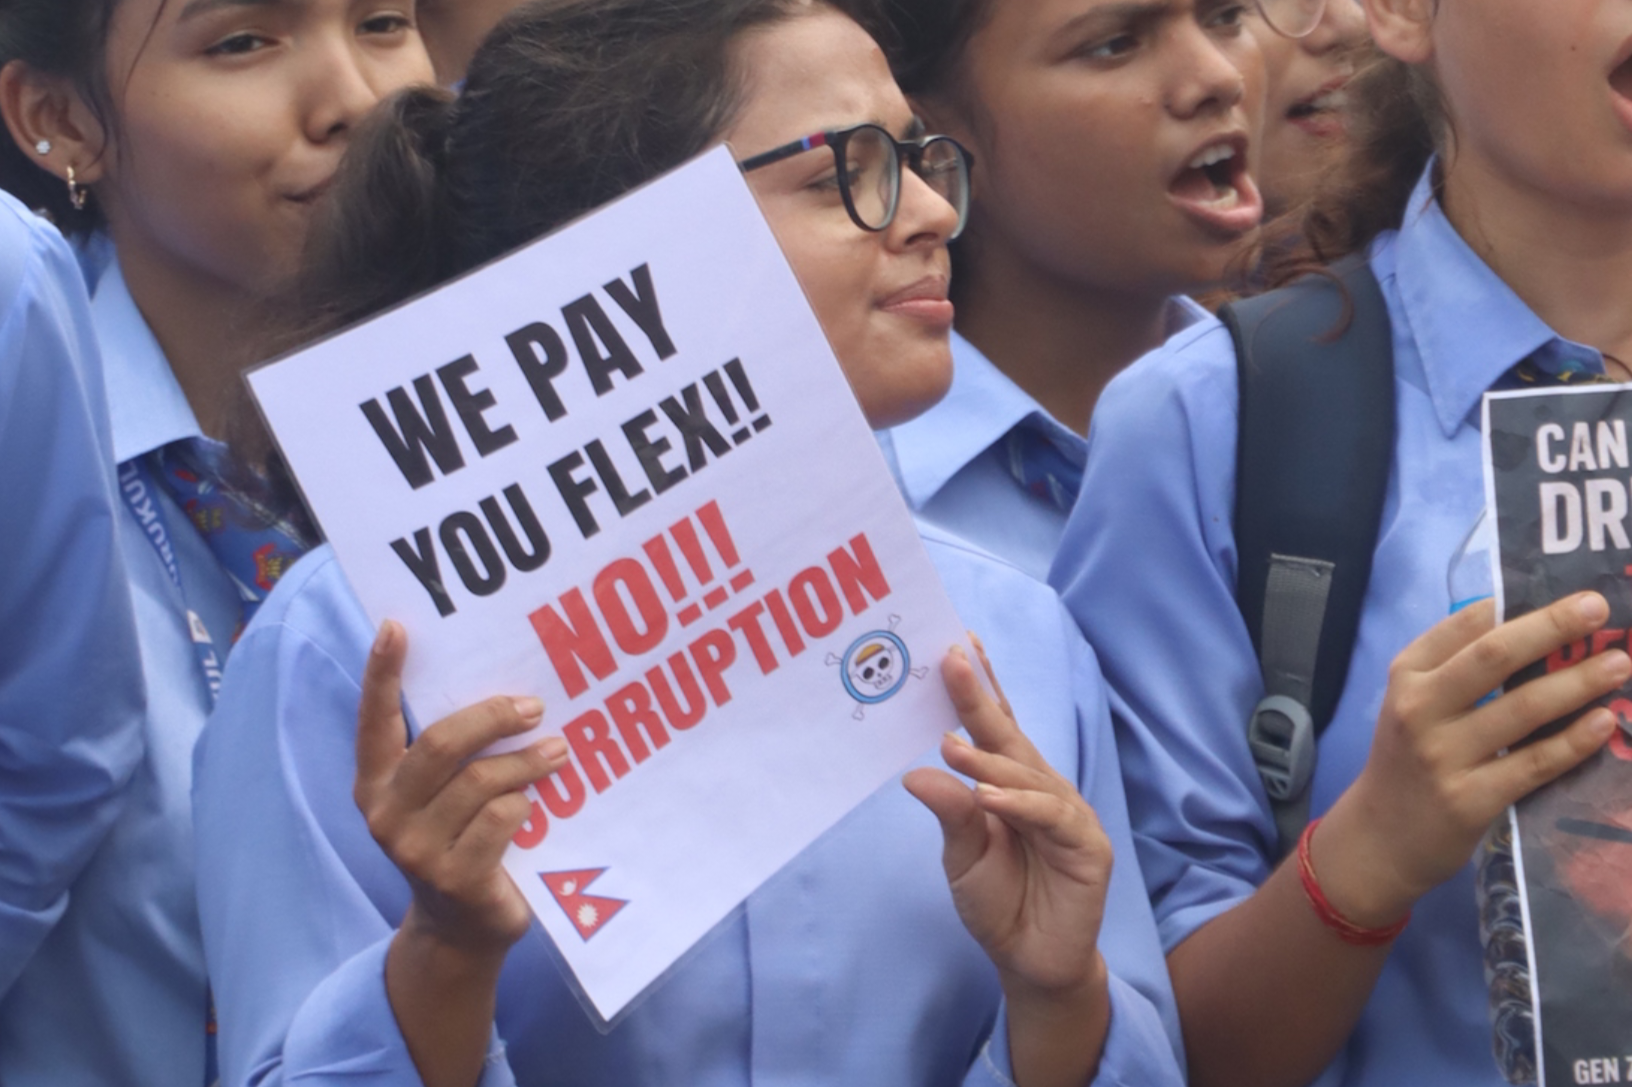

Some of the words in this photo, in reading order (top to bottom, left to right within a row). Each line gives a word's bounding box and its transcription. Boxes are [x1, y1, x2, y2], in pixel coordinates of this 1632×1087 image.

[359, 353, 518, 491] WE
[504, 262, 678, 423] PAY
[1536, 420, 1630, 474] CAN
[389, 483, 551, 618] YOU
[547, 358, 774, 539] FLEX!!
[527, 499, 755, 701] NO!!!
[1573, 1058, 1620, 1085] GEN
